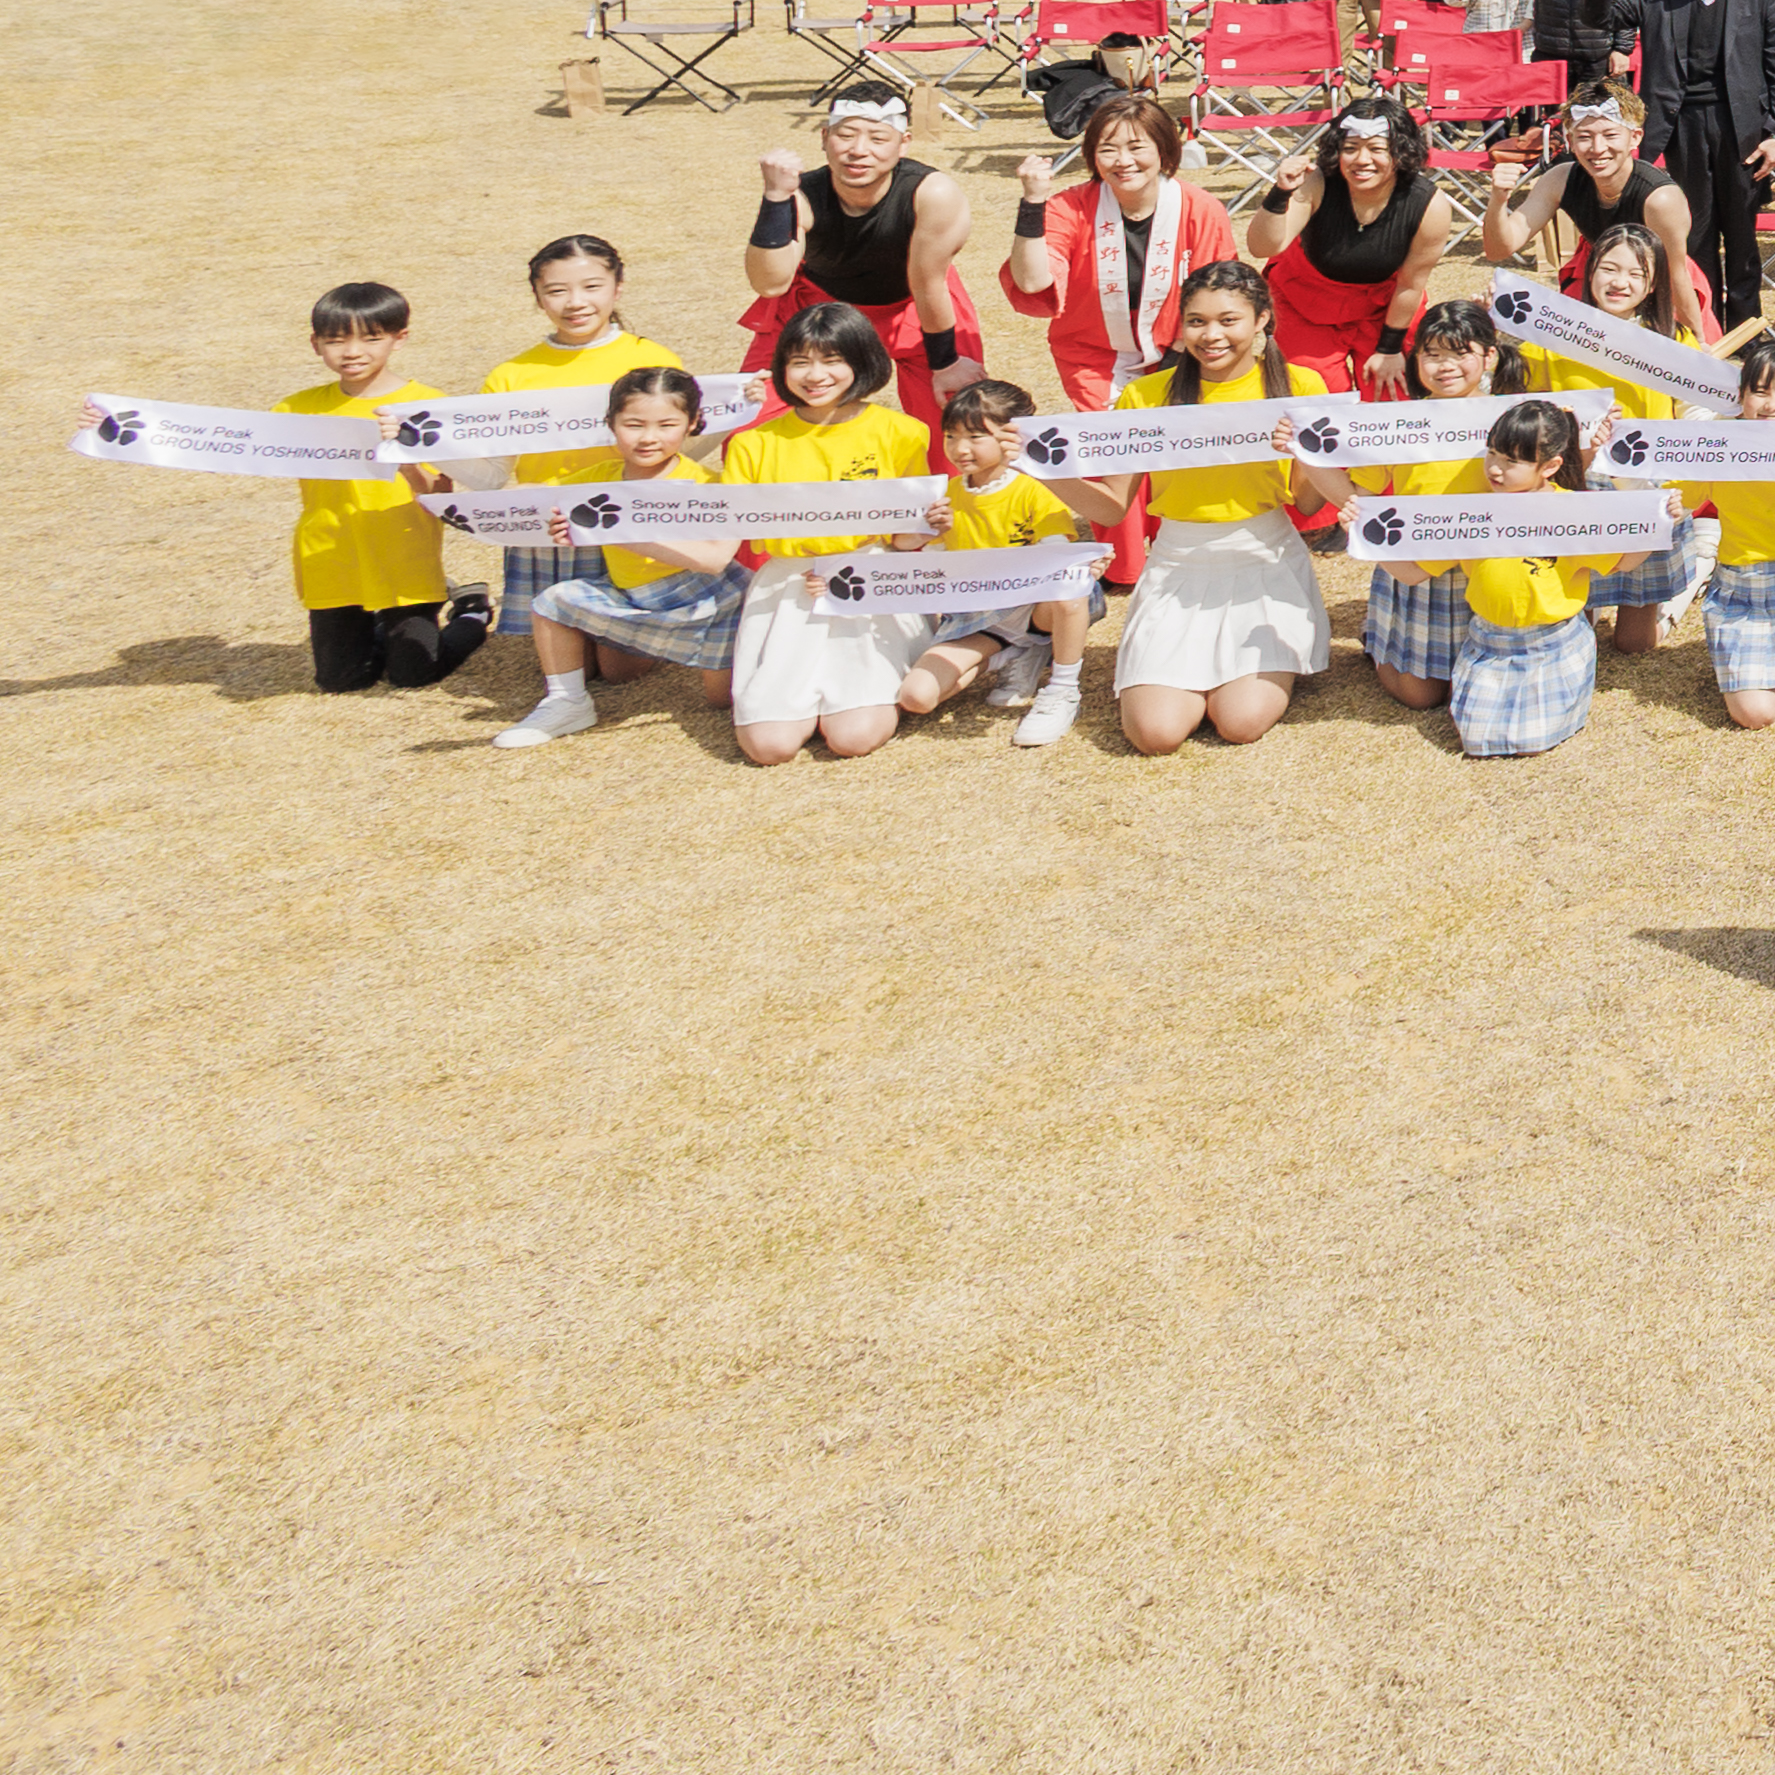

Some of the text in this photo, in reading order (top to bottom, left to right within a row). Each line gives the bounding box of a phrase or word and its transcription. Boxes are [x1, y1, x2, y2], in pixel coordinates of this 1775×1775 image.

[1539, 305, 1607, 342] Snow Peak
[1534, 320, 1738, 405] GROUNDS YOSHINOGARI OPEN
[453, 408, 549, 425] Snow Peak
[453, 423, 548, 440] GROUNDS
[702, 402, 744, 417] PEN!
[159, 420, 253, 440] Snow Peak
[1348, 418, 1431, 433] Snow Peak
[1078, 426, 1166, 443] Snow Peak
[1348, 429, 1492, 447] GROUNDS YOSHIN
[1656, 436, 1728, 449] Snow Peak
[151, 434, 245, 456] GROUNDS
[252, 444, 361, 461] YOSHINOGARI
[1077, 430, 1278, 459] GROUNDS YOSHINOGA
[1654, 451, 1725, 463] GROUNDS
[632, 499, 729, 510] Snow Peak
[473, 506, 539, 520] Snow Peak
[632, 513, 727, 523] GROUNDS
[735, 510, 861, 523] YOSHINOGARI
[1413, 512, 1493, 525] Snow Peak
[478, 520, 541, 534] GROUNDS
[1412, 523, 1656, 541] GROUNDS YOSHINOGARI OPEN!
[871, 569, 946, 582] Snow Peak
[873, 583, 946, 597] GROUNDS
